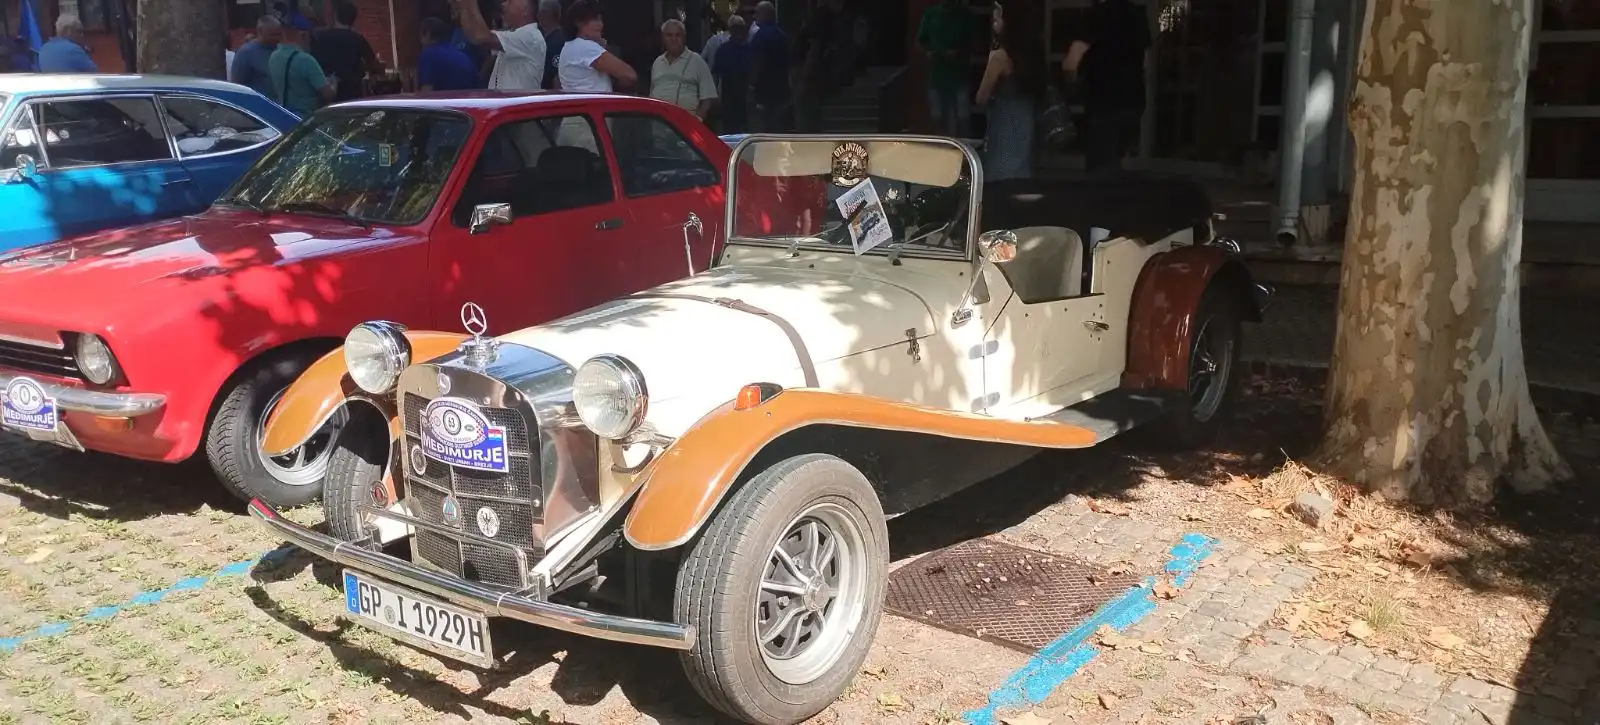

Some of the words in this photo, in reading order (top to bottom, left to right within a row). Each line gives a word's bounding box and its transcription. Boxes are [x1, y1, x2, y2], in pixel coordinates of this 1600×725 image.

[845, 142, 868, 160] ANTIQUE
[423, 432, 503, 463] MEĐIMURJE
[358, 581, 381, 617] GP
[397, 595, 408, 629] I
[412, 601, 485, 653] 1929H
